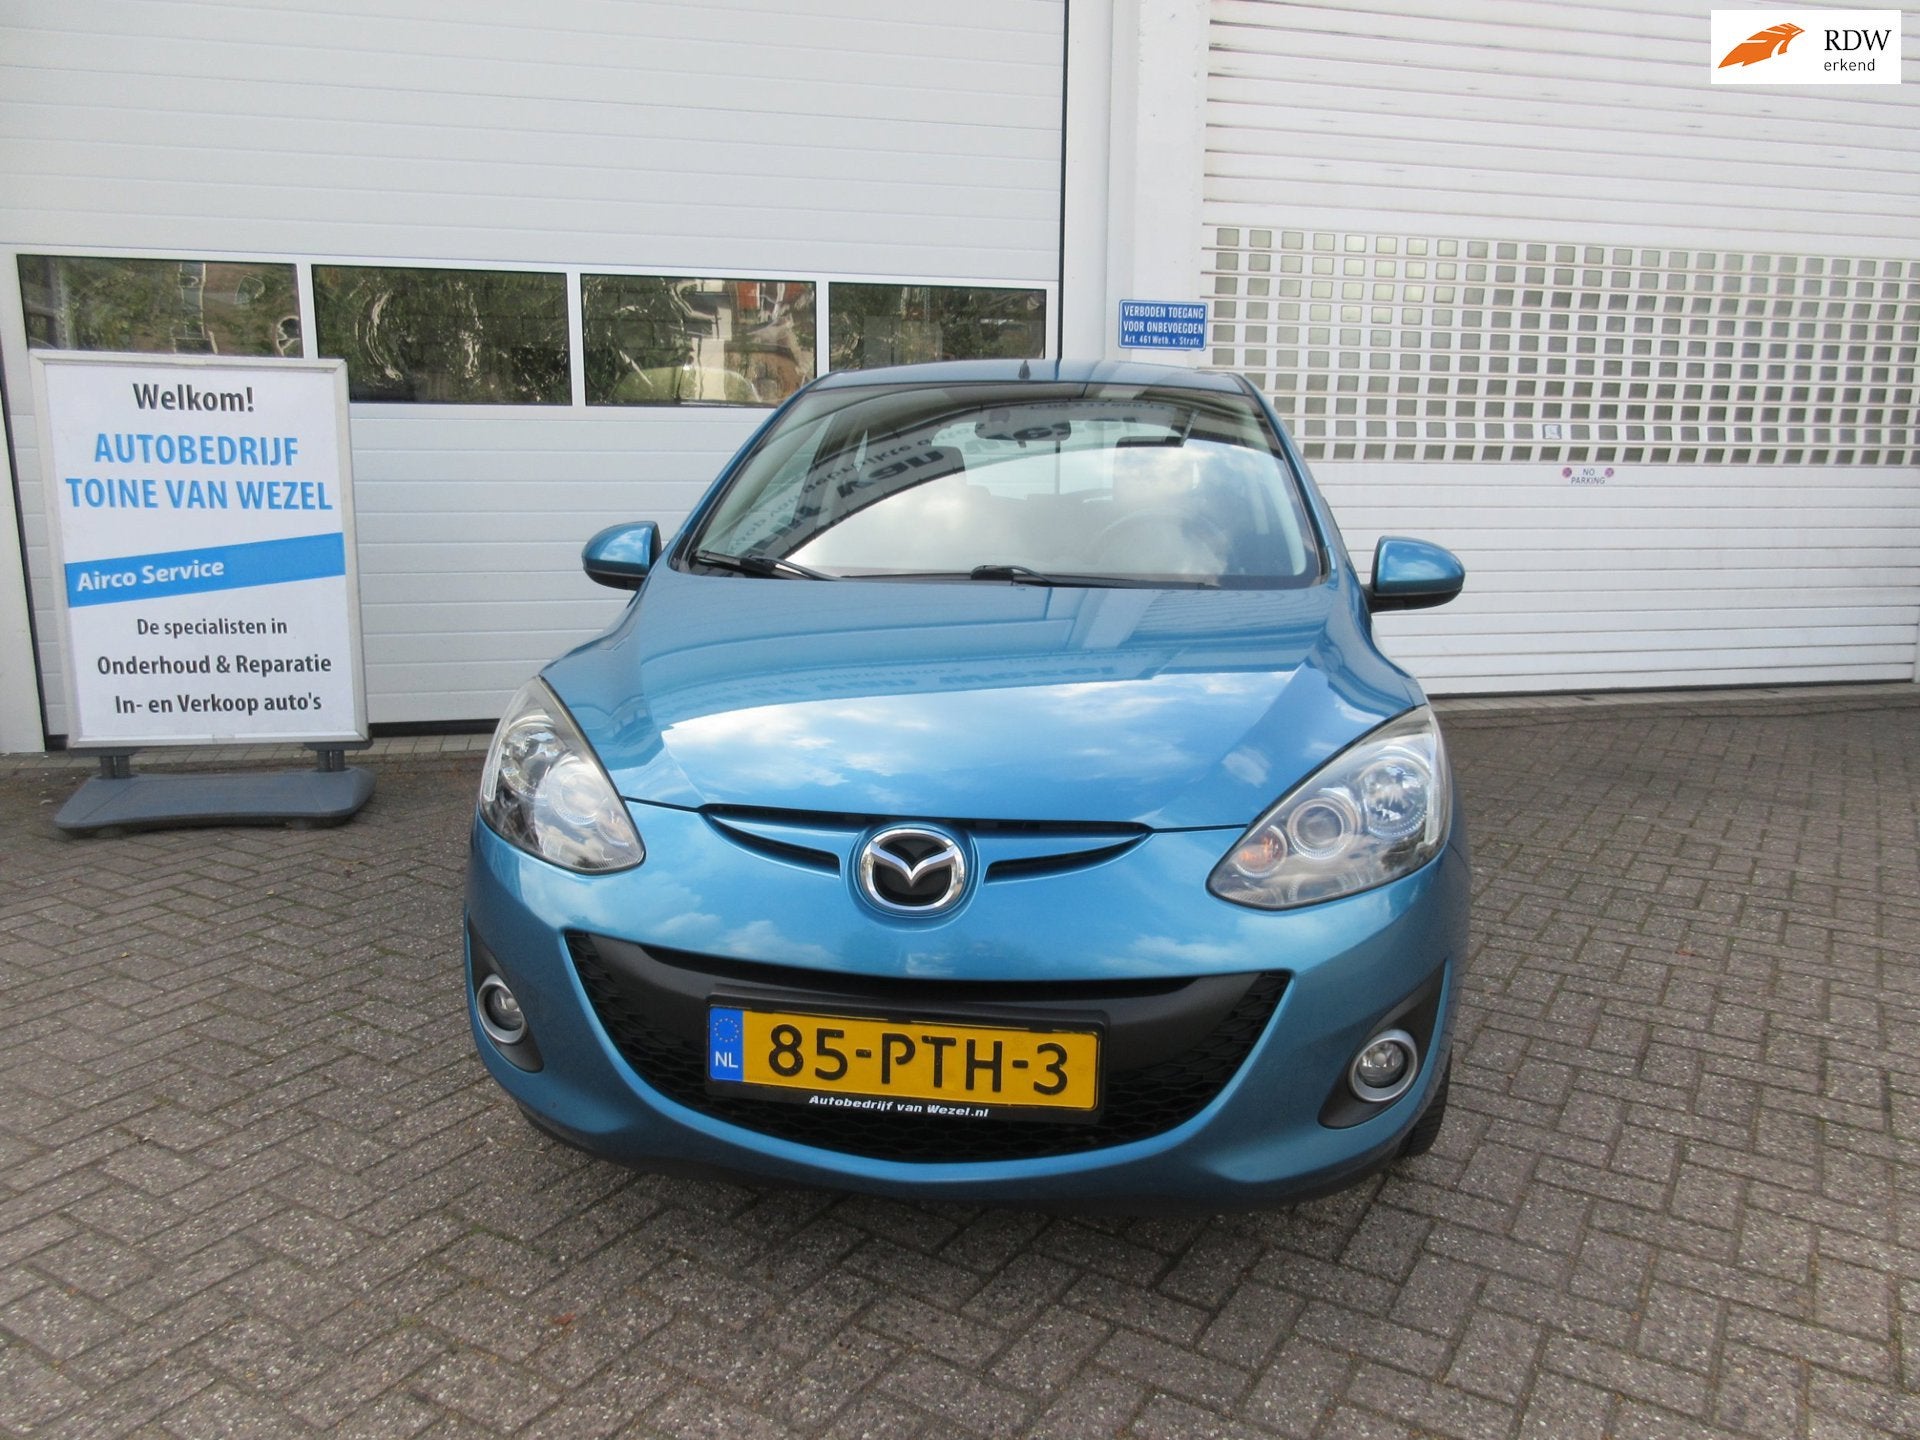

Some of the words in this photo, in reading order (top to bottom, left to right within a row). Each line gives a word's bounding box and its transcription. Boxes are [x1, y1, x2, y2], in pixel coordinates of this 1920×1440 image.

[1123, 305, 1166, 318] VERBODEN
[1168, 307, 1204, 319] TOEGANG
[1123, 320, 1145, 332] VOOR
[1146, 321, 1204, 334] ONBEVOEGDEN
[1124, 334, 1138, 343] Art.
[1139, 335, 1151, 343] 461
[132, 383, 254, 413] Welkom!
[94, 433, 299, 466] AUTOBEDRIJF
[1570, 476, 1606, 485] PARKING
[1582, 468, 1596, 476] NO
[65, 477, 159, 508] TOINE
[164, 479, 229, 510] VAN
[235, 480, 333, 511] WEZEL
[76, 570, 137, 593] Airco
[141, 560, 225, 585] Service
[137, 618, 160, 636] De
[164, 618, 267, 639] specialisten
[271, 618, 288, 635] in
[97, 654, 211, 675] Onderhoud
[216, 656, 231, 674] &
[235, 654, 332, 678] Reparatie
[115, 695, 143, 714] In-
[148, 698, 173, 713] en
[177, 694, 260, 716] Verkoop
[263, 692, 322, 711] auto's
[715, 1050, 739, 1069] NL
[767, 1023, 1069, 1096] 85-PTH-3
[808, 1094, 895, 1112] Autobedrijf
[896, 1103, 923, 1113] van
[926, 1104, 990, 1118] Wezel.nl
